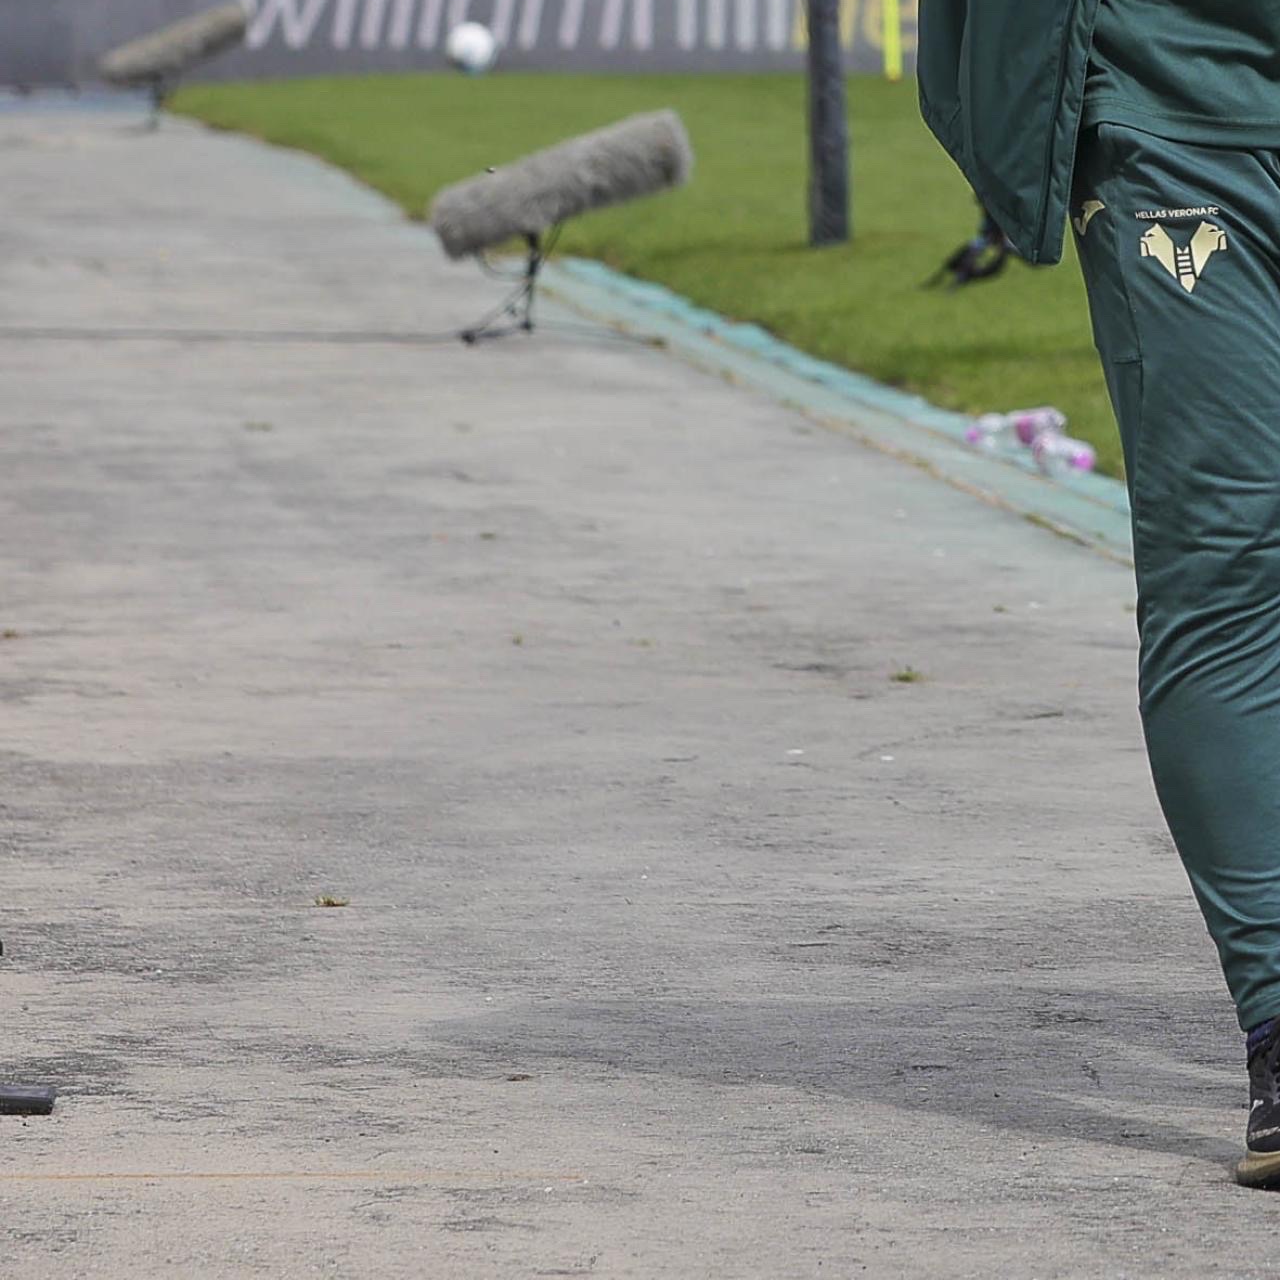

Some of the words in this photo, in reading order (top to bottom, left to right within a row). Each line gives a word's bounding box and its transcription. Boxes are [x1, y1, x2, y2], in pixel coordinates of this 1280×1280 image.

[1135, 209, 1167, 219] HELLAS
[1168, 207, 1206, 218] VERONA
[1207, 206, 1219, 215] FC
